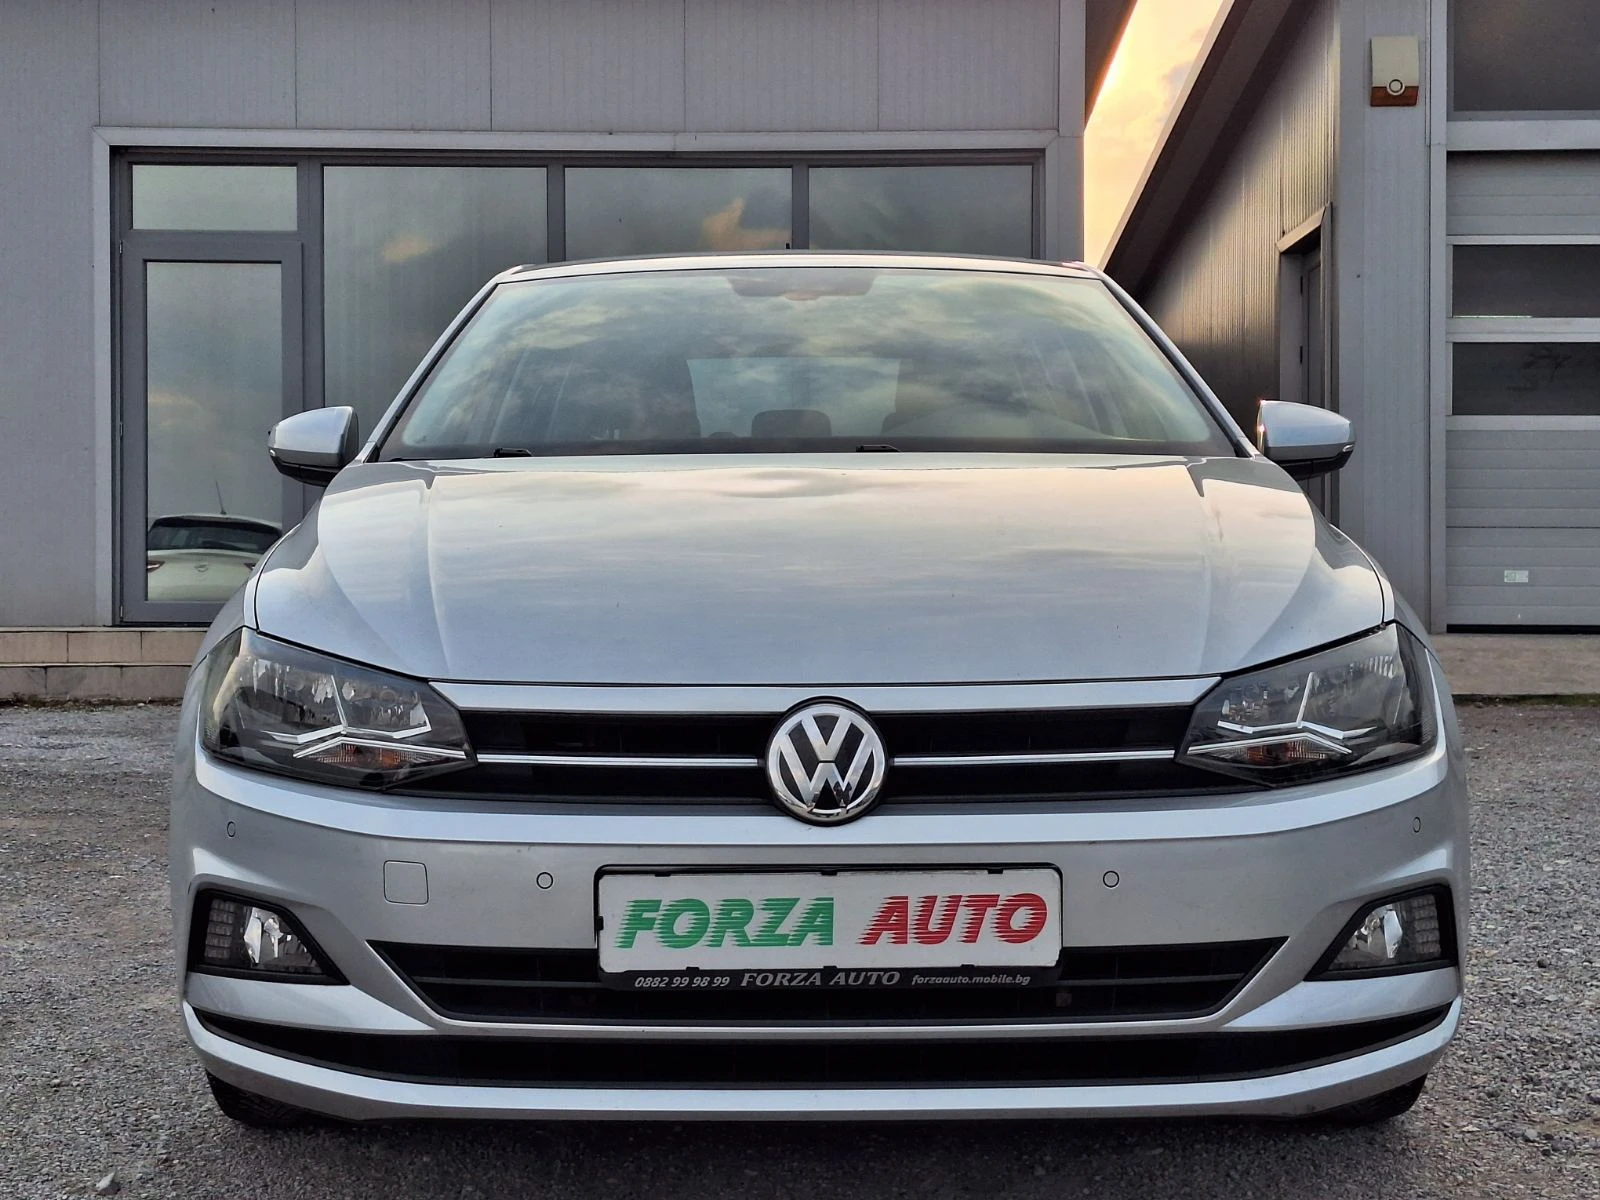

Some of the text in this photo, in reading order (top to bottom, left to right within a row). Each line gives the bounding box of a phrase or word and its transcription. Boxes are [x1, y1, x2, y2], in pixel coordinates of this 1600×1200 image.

[771, 705, 882, 812] VW
[613, 893, 1048, 949] FORZA AUTO
[634, 971, 1031, 988] 0882 99 98 99 FORZA AUTO forzaauto.mobile.bg
